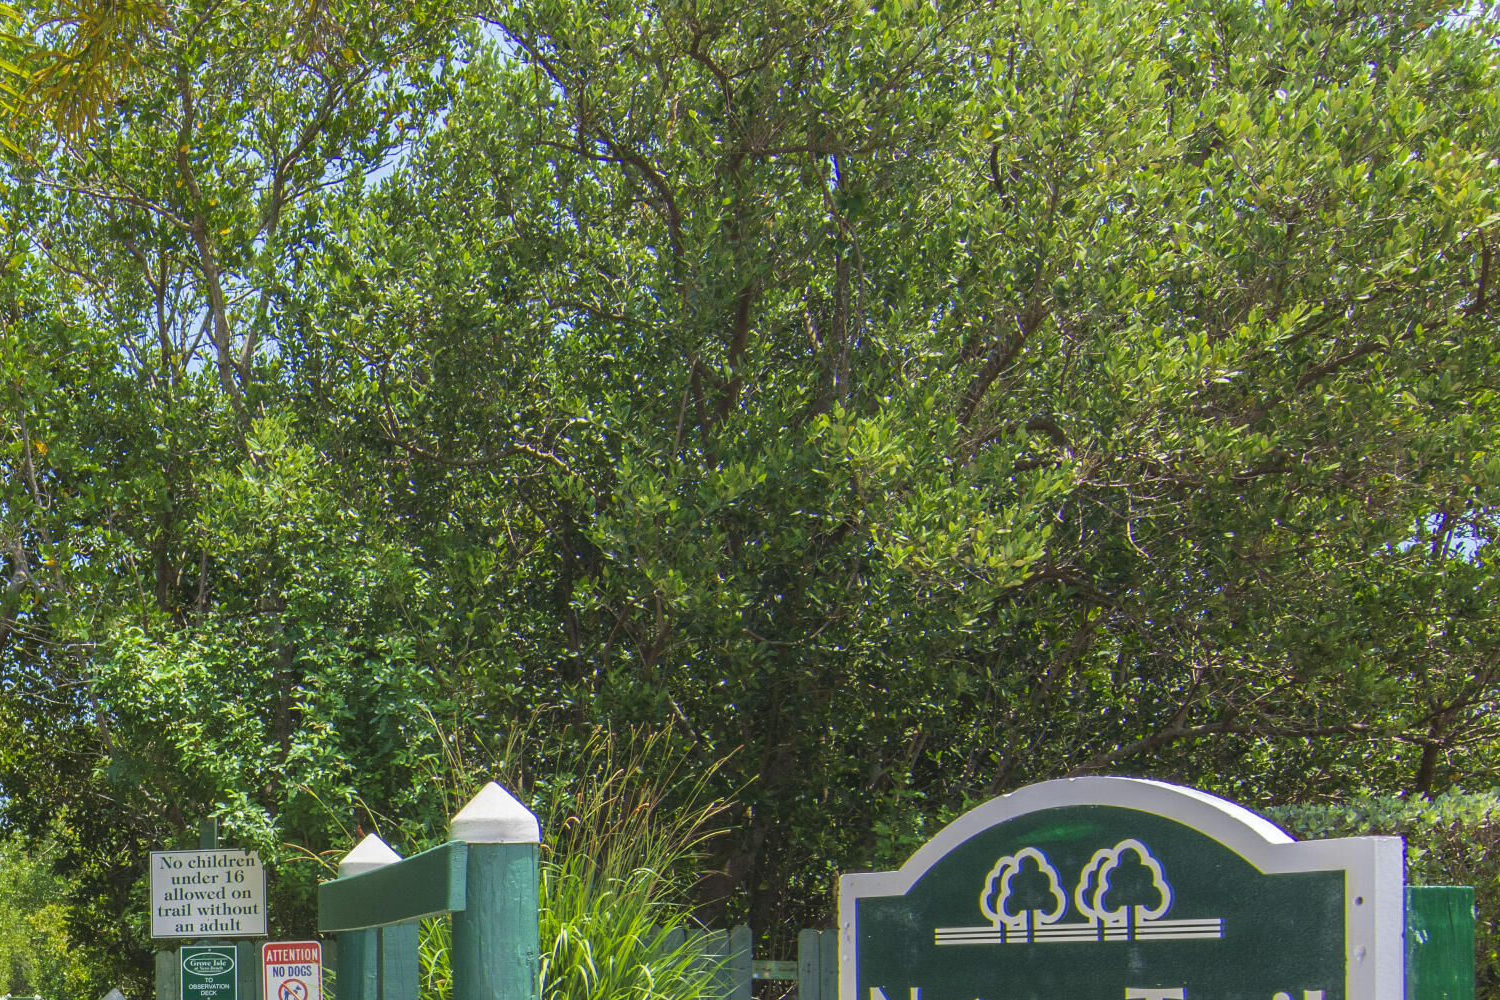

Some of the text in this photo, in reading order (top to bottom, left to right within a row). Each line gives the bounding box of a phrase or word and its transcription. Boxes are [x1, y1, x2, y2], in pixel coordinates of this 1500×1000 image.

[160, 855, 255, 869] No children
[171, 870, 244, 885] under 16
[164, 887, 252, 900] allowed on
[158, 903, 259, 917] trail without
[175, 919, 242, 932] an adult
[266, 948, 318, 961] ATTENTION
[272, 965, 312, 977] NO DOGS
